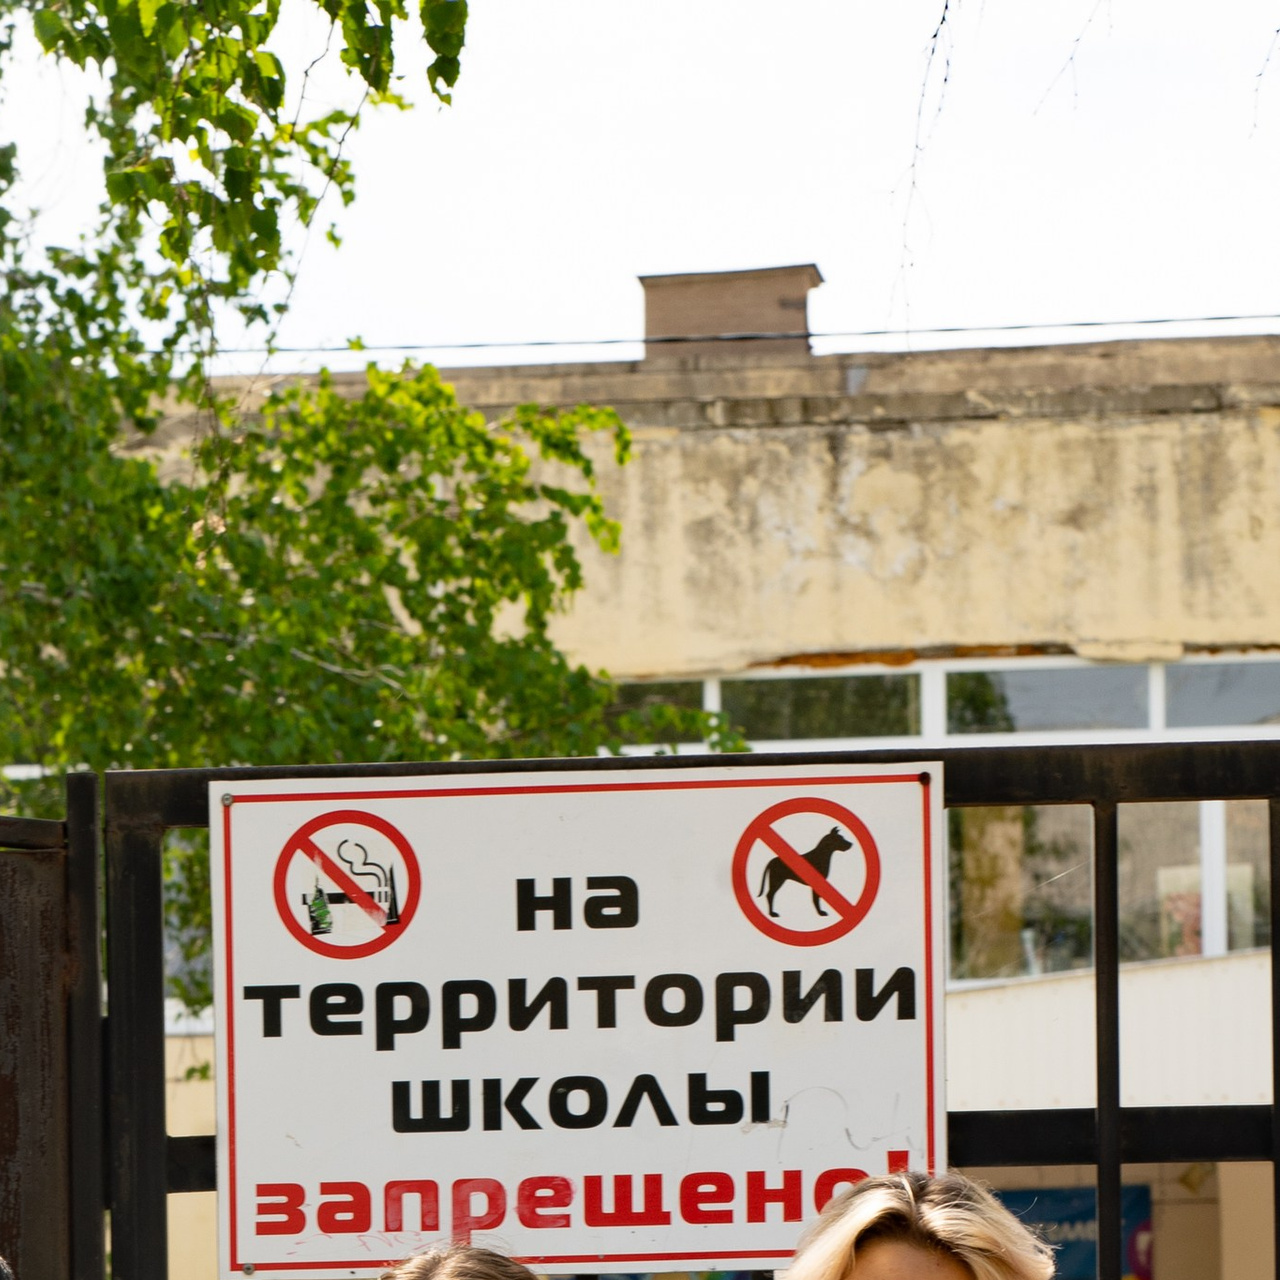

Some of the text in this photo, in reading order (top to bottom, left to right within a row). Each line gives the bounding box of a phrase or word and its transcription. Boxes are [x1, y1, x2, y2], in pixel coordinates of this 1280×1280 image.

[516, 875, 640, 932] на
[243, 966, 917, 1053] территории
[391, 1071, 771, 1134] школы
